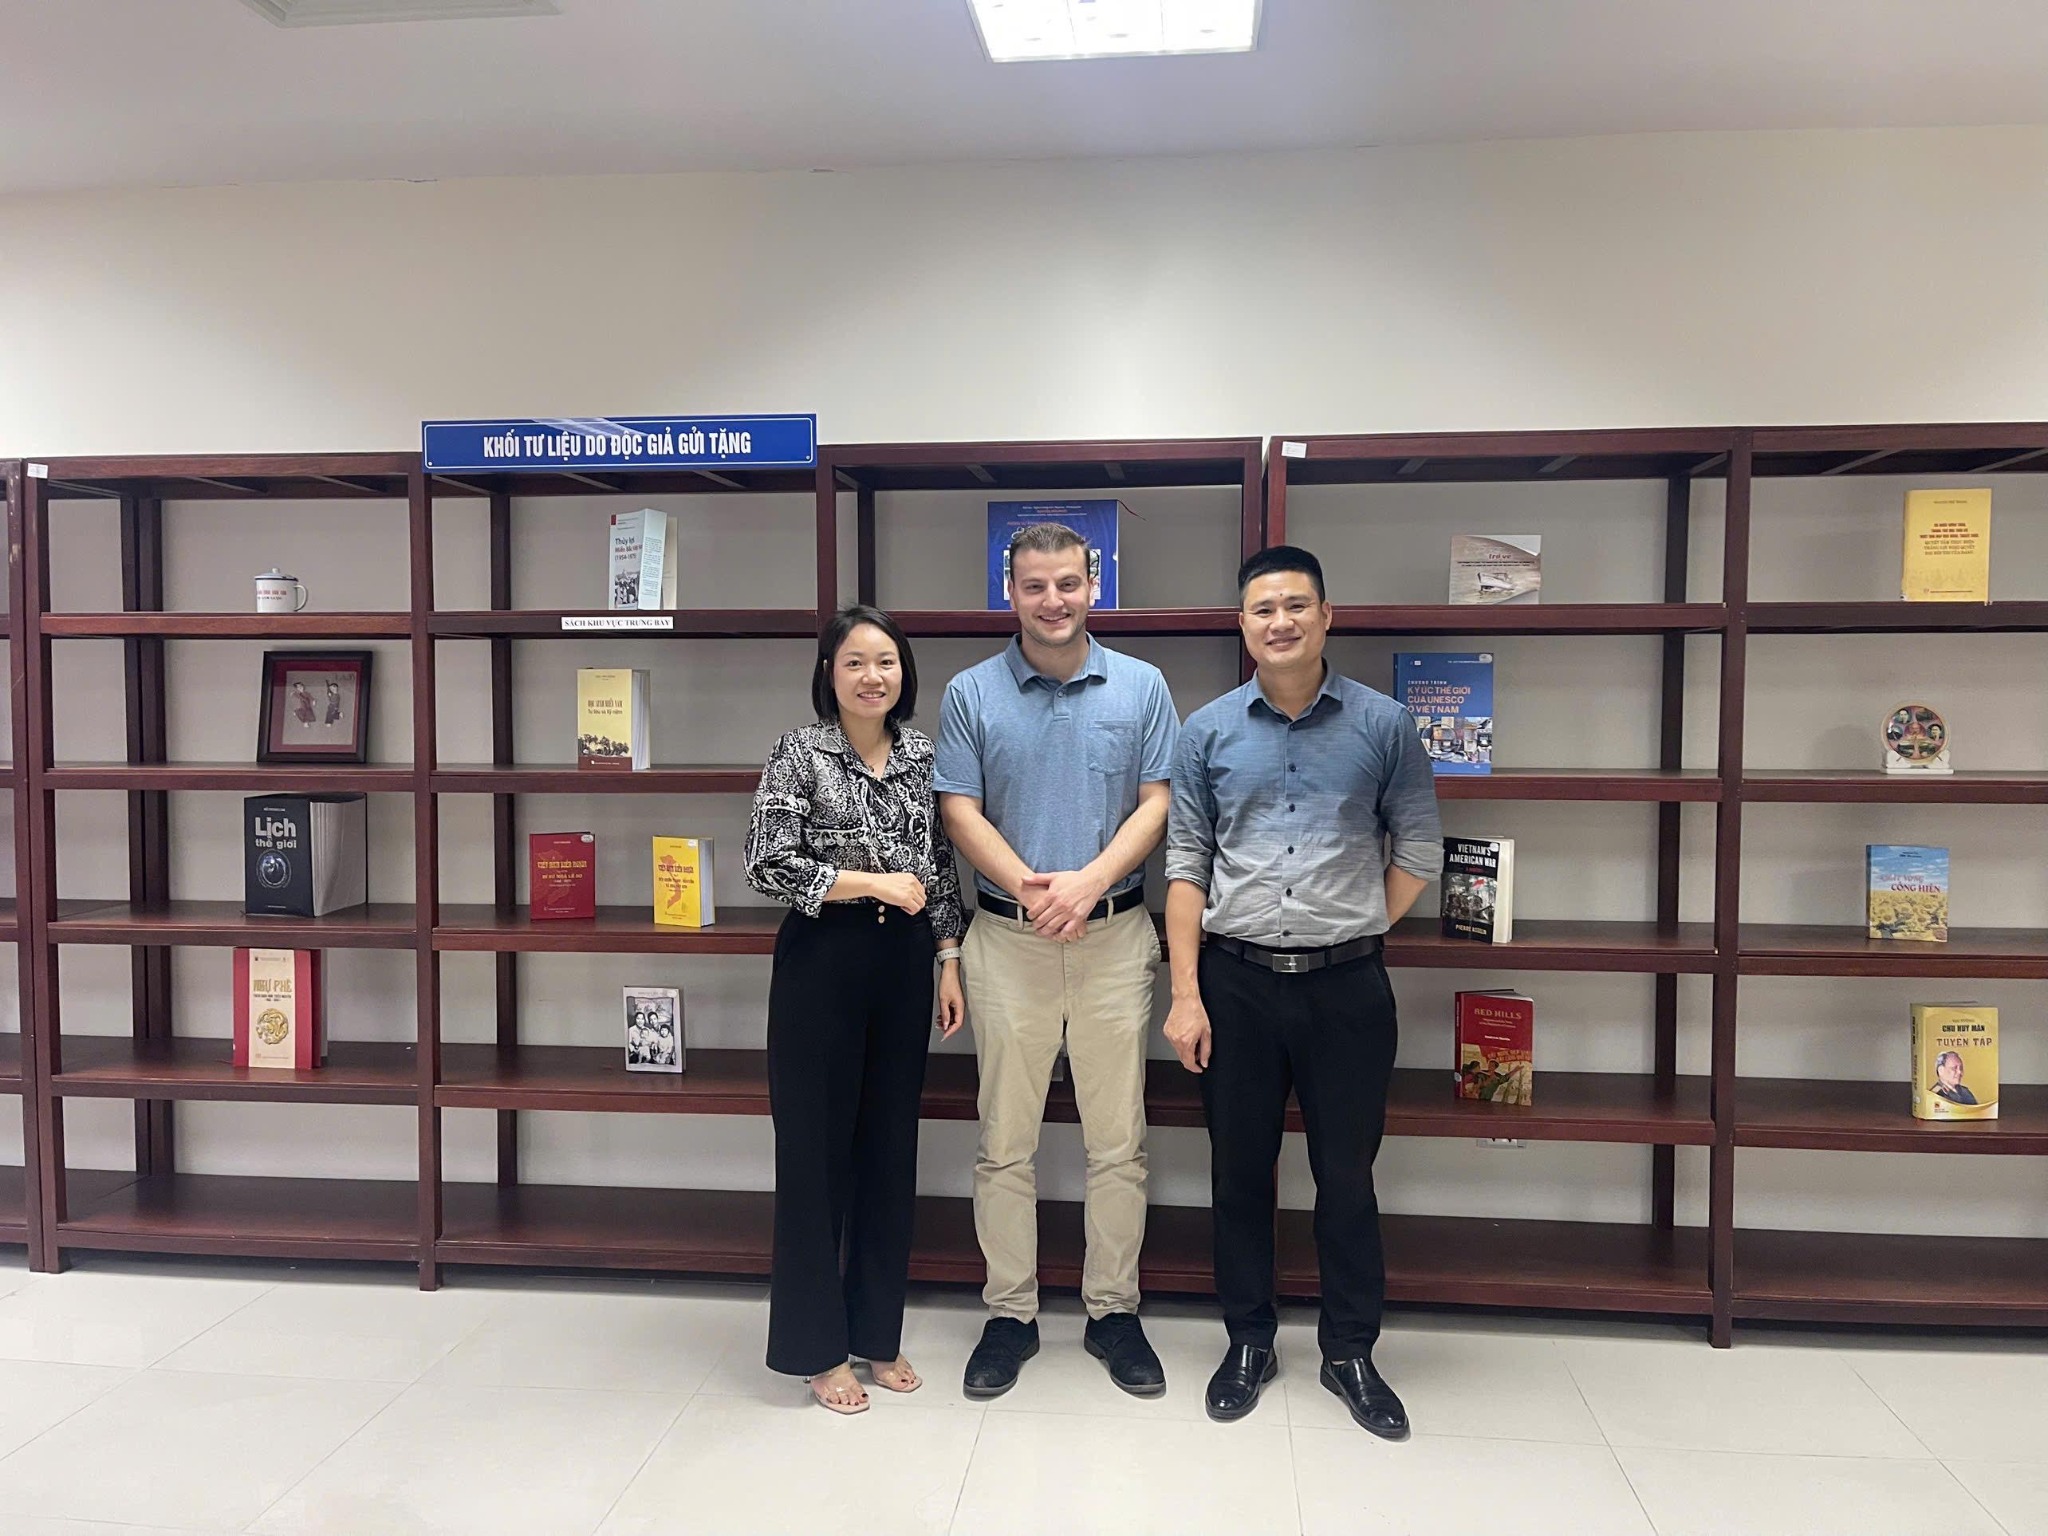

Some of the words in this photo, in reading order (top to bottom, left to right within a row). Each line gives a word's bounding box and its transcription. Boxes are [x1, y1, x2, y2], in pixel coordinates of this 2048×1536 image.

[484, 428, 520, 458] KHỐI
[524, 433, 545, 458] TƯ
[548, 430, 581, 461] LIỆU
[585, 434, 606, 457] DO
[610, 430, 643, 460] ĐỘC
[647, 426, 675, 455] GIẢ
[678, 426, 705, 455] GỬI
[709, 427, 752, 459] TẶNG
[587, 618, 605, 627] KHU
[1427, 695, 1465, 704] UNESCO
[1437, 705, 1459, 714] NAM
[255, 817, 297, 840] Lịch
[1457, 843, 1492, 857] VIETNAM'S
[1449, 853, 1484, 866] AMERICAN
[1484, 857, 1497, 868] WAR
[1474, 1007, 1493, 1017] RED
[1494, 1009, 1522, 1020] HILLS
[1942, 1024, 1956, 1033] CHU
[1957, 1024, 1970, 1032] HUY
